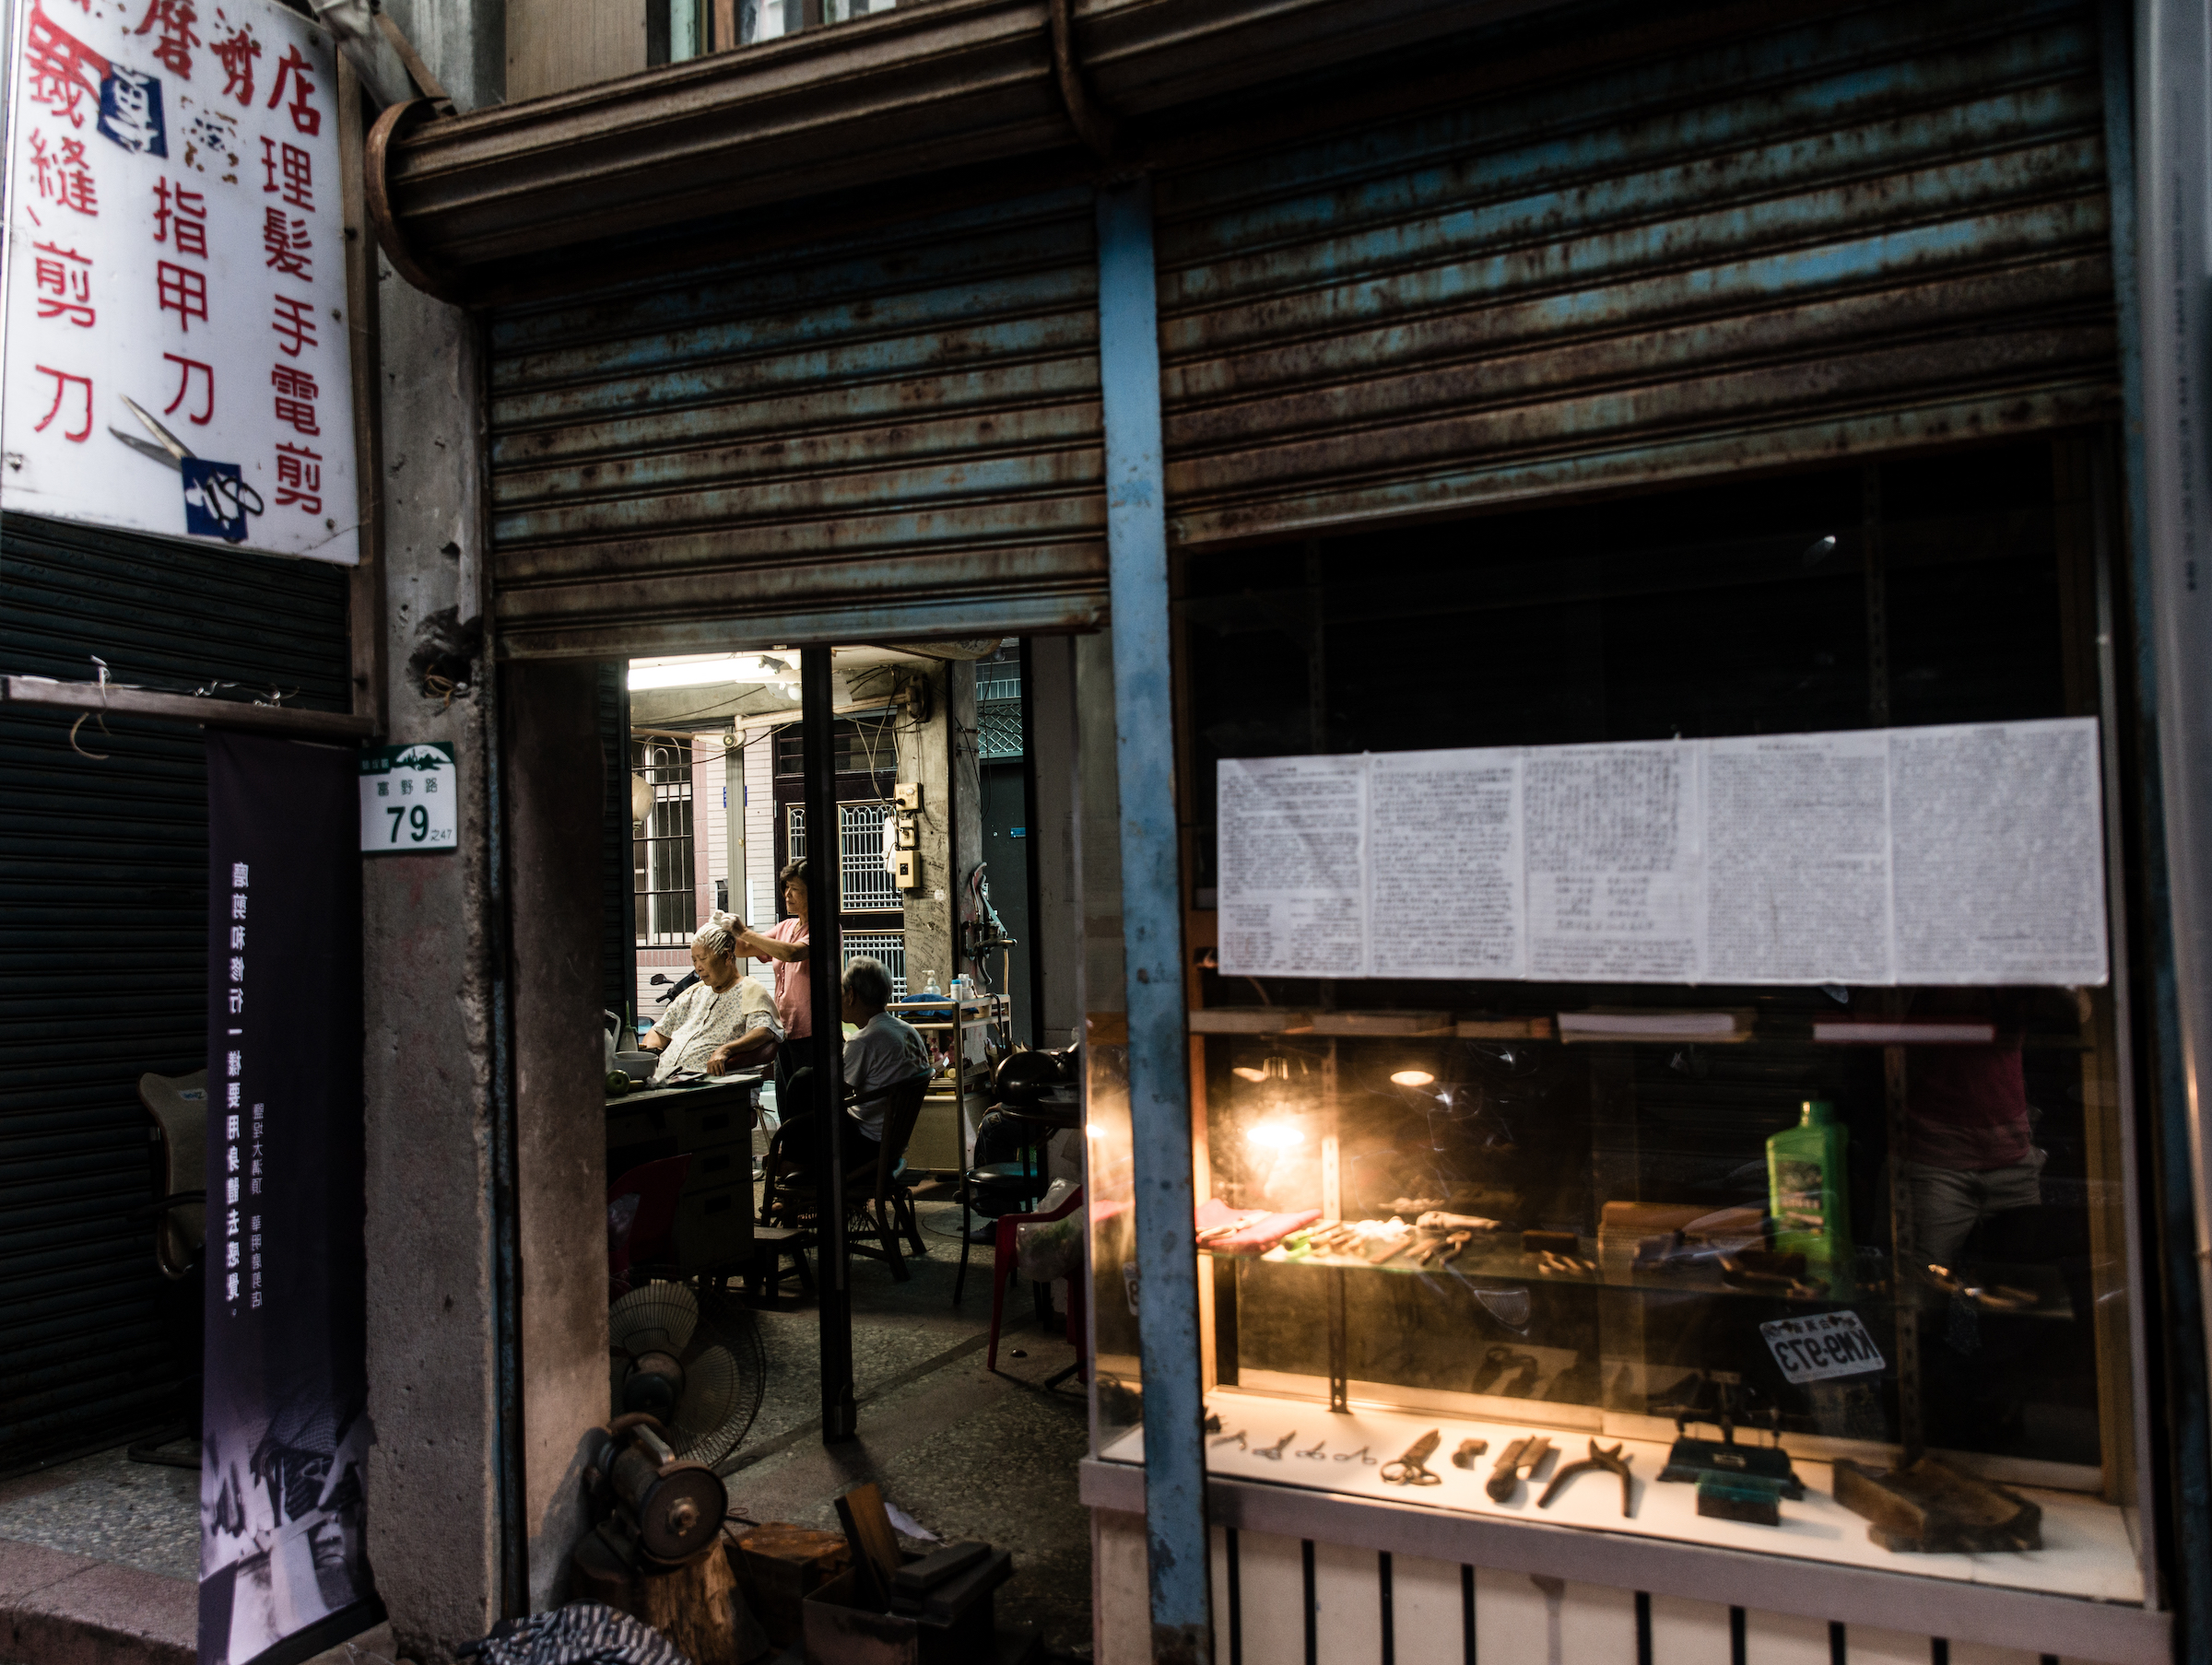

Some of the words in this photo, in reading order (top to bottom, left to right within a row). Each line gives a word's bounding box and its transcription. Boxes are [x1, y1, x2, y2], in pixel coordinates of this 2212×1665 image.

[70, 0, 322, 136] 磨剪店
[153, 176, 215, 426] 指甲刀
[260, 135, 323, 514] 理髮手電剪
[377, 778, 438, 796] 富野路
[387, 804, 429, 843] 79
